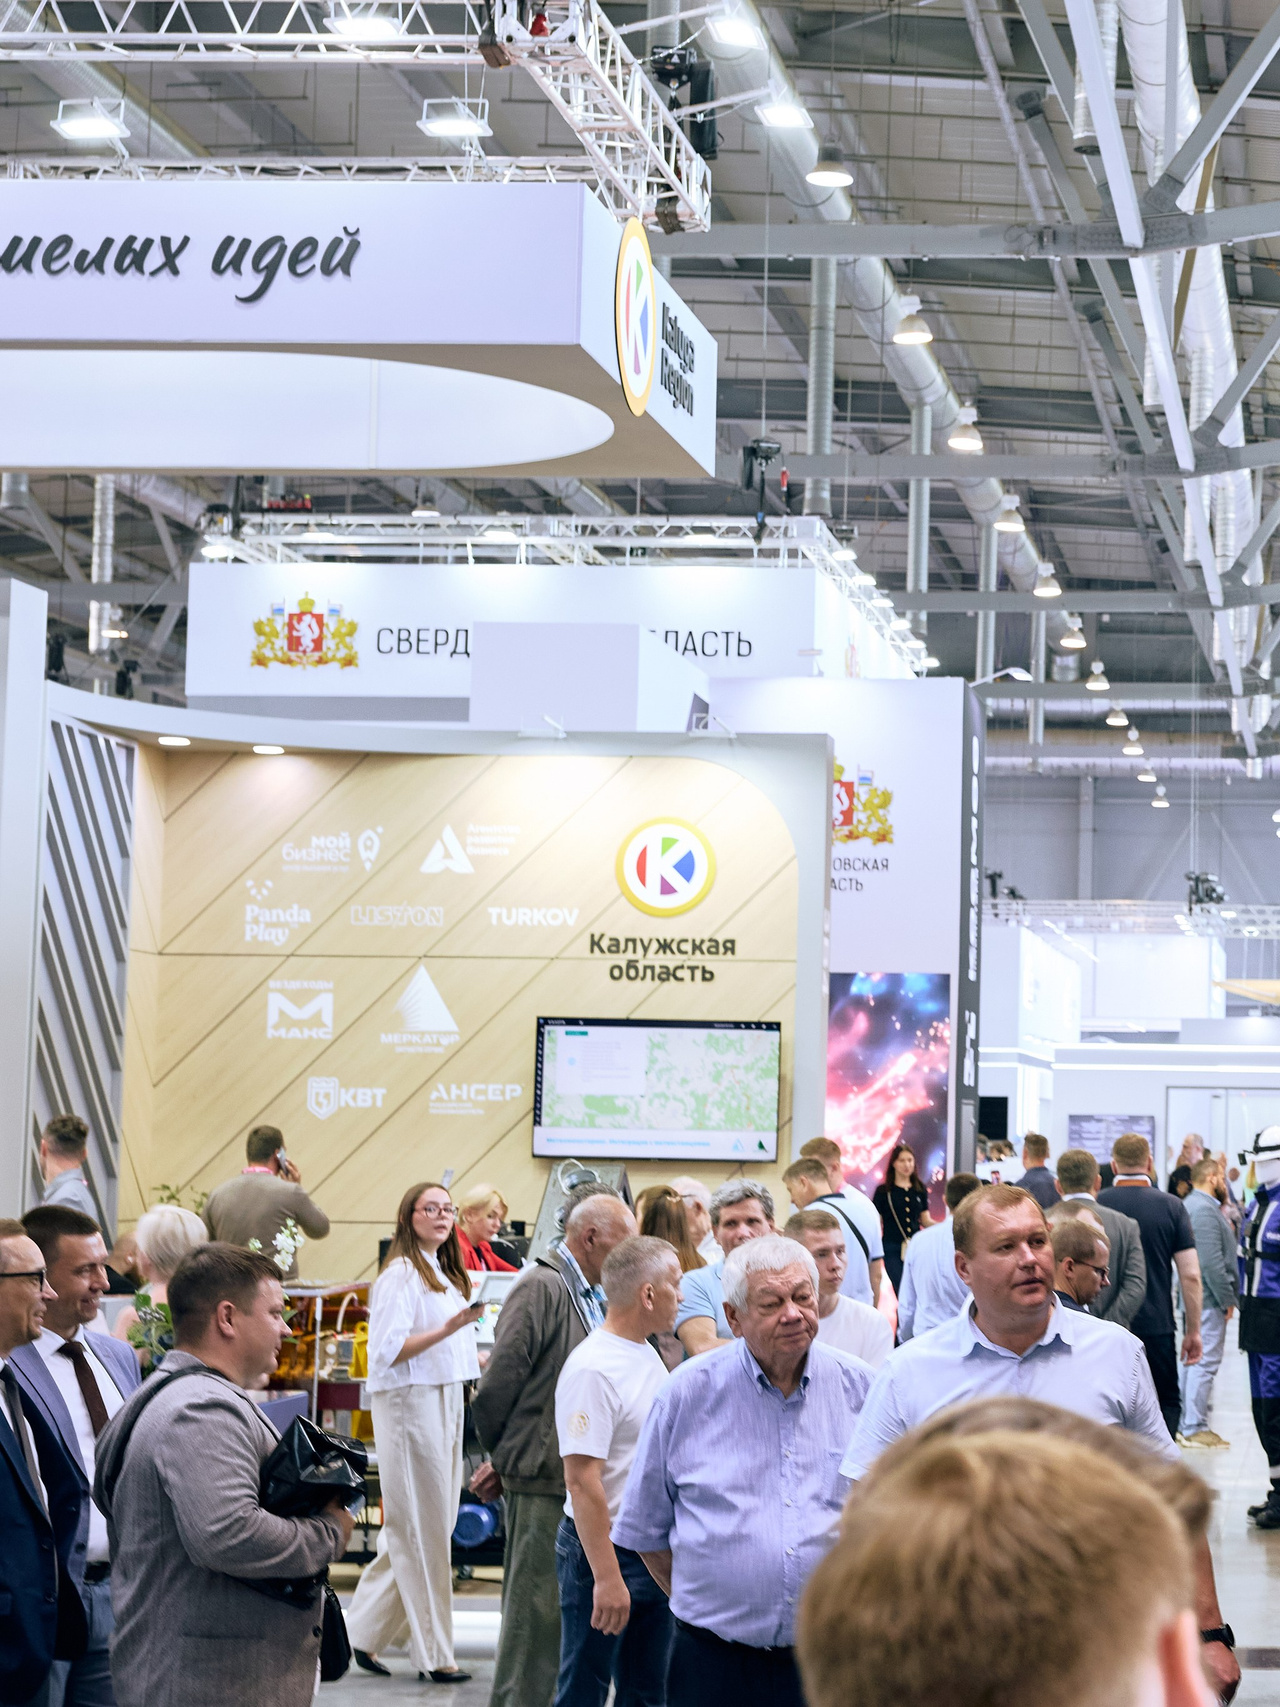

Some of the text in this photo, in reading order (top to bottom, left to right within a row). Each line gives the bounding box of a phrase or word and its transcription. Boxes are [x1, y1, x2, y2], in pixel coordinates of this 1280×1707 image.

[211, 226, 361, 303] идей
[661, 302, 695, 373] Kaluga
[660, 347, 694, 416] Region
[281, 843, 351, 862] бизнес
[245, 903, 311, 923] Panda
[488, 906, 580, 927] TURKOV
[245, 924, 290, 946] Play
[589, 933, 736, 958] Калужская
[608, 960, 715, 983] область
[267, 1027, 333, 1040] МАКС
[340, 1087, 387, 1108] КВТ
[429, 1083, 523, 1101] АНСЕР
